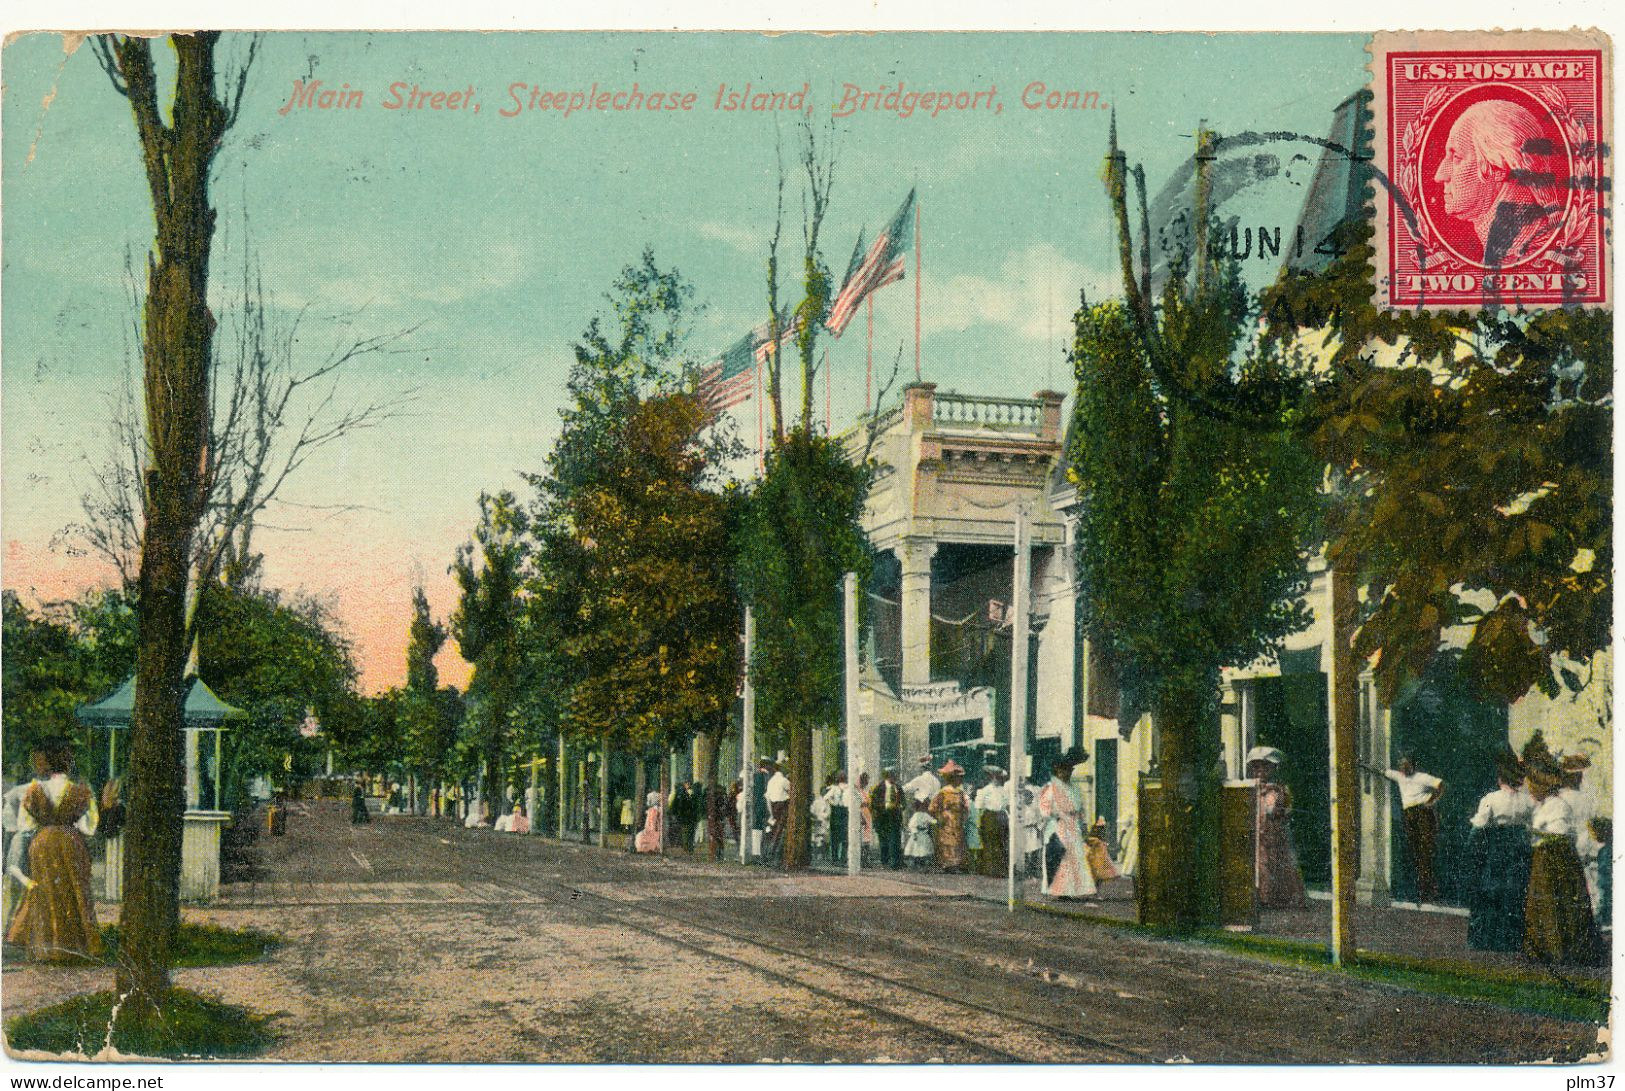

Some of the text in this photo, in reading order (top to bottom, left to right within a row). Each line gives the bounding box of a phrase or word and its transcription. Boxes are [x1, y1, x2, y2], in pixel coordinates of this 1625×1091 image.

[277, 79, 1110, 118] Main Street, Steeplechase Island, Bridgeport, Conn.
[1406, 273, 1590, 292] TWO CENTS
